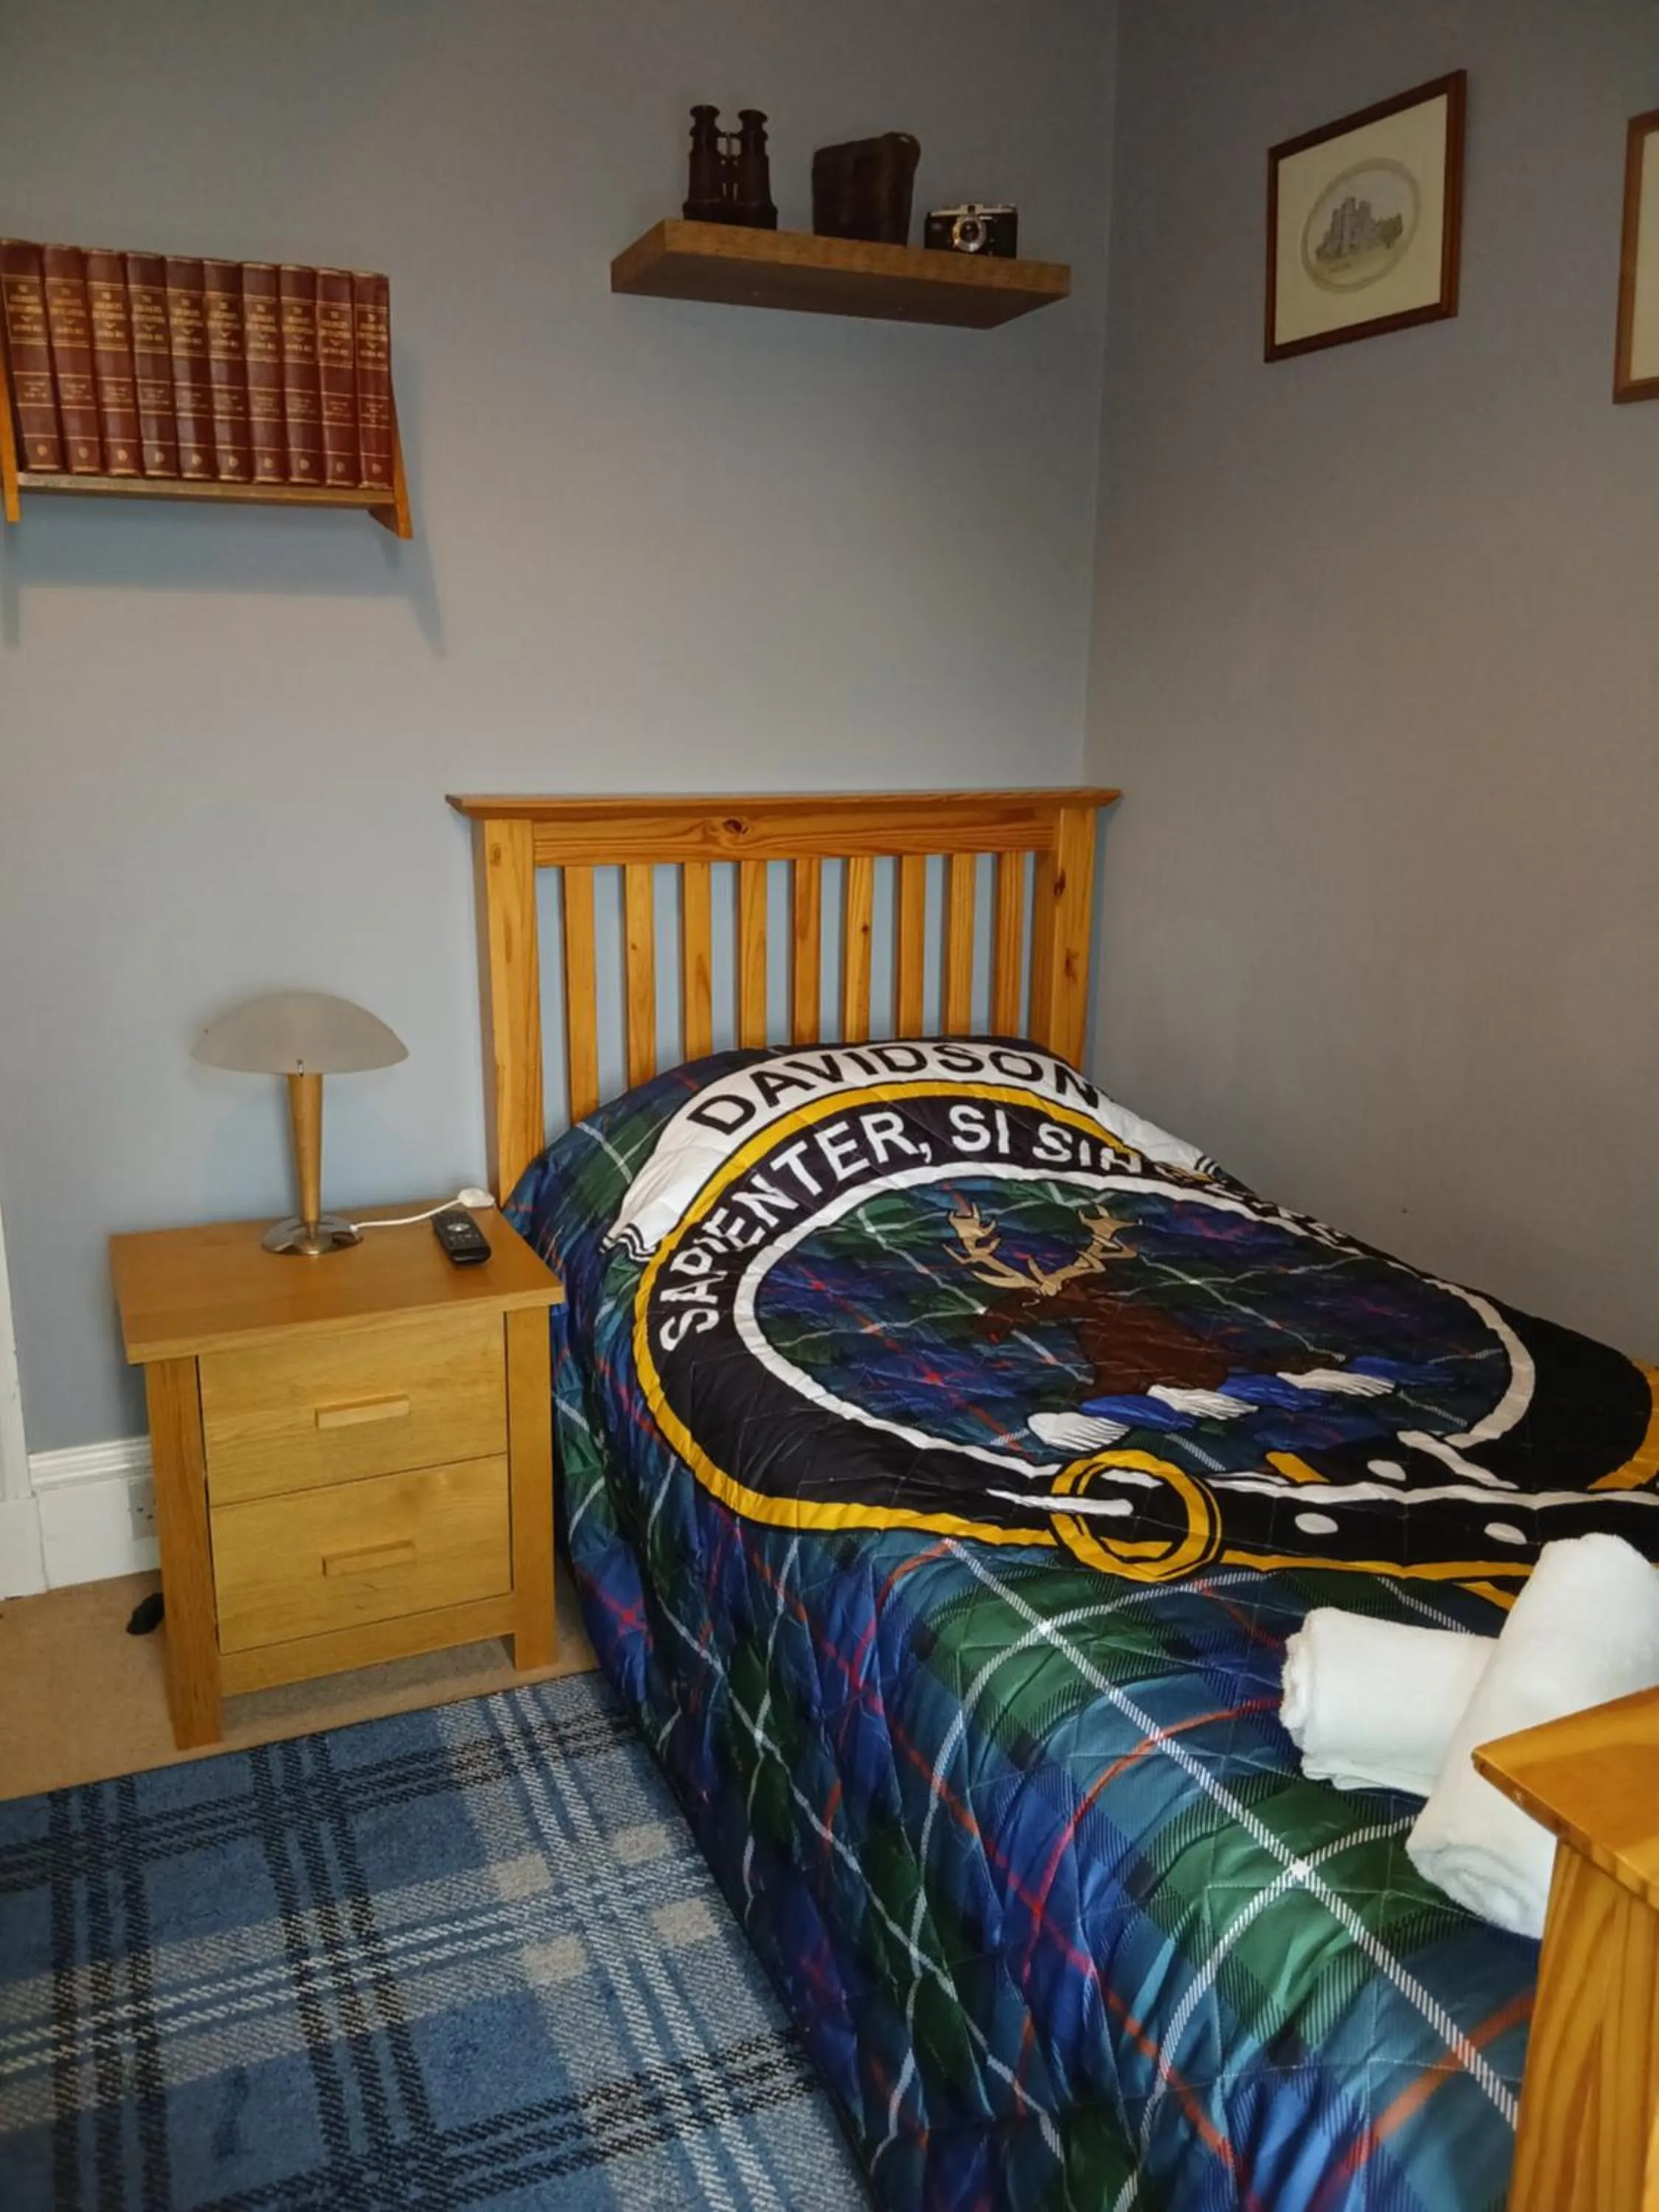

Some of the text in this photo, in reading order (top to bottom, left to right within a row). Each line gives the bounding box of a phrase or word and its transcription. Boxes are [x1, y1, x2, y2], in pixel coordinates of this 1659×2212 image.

[686, 1043, 1099, 1136] DAVIDSON
[659, 1111, 932, 1352] SAPIENTER,
[949, 1105, 1011, 1155] SI
